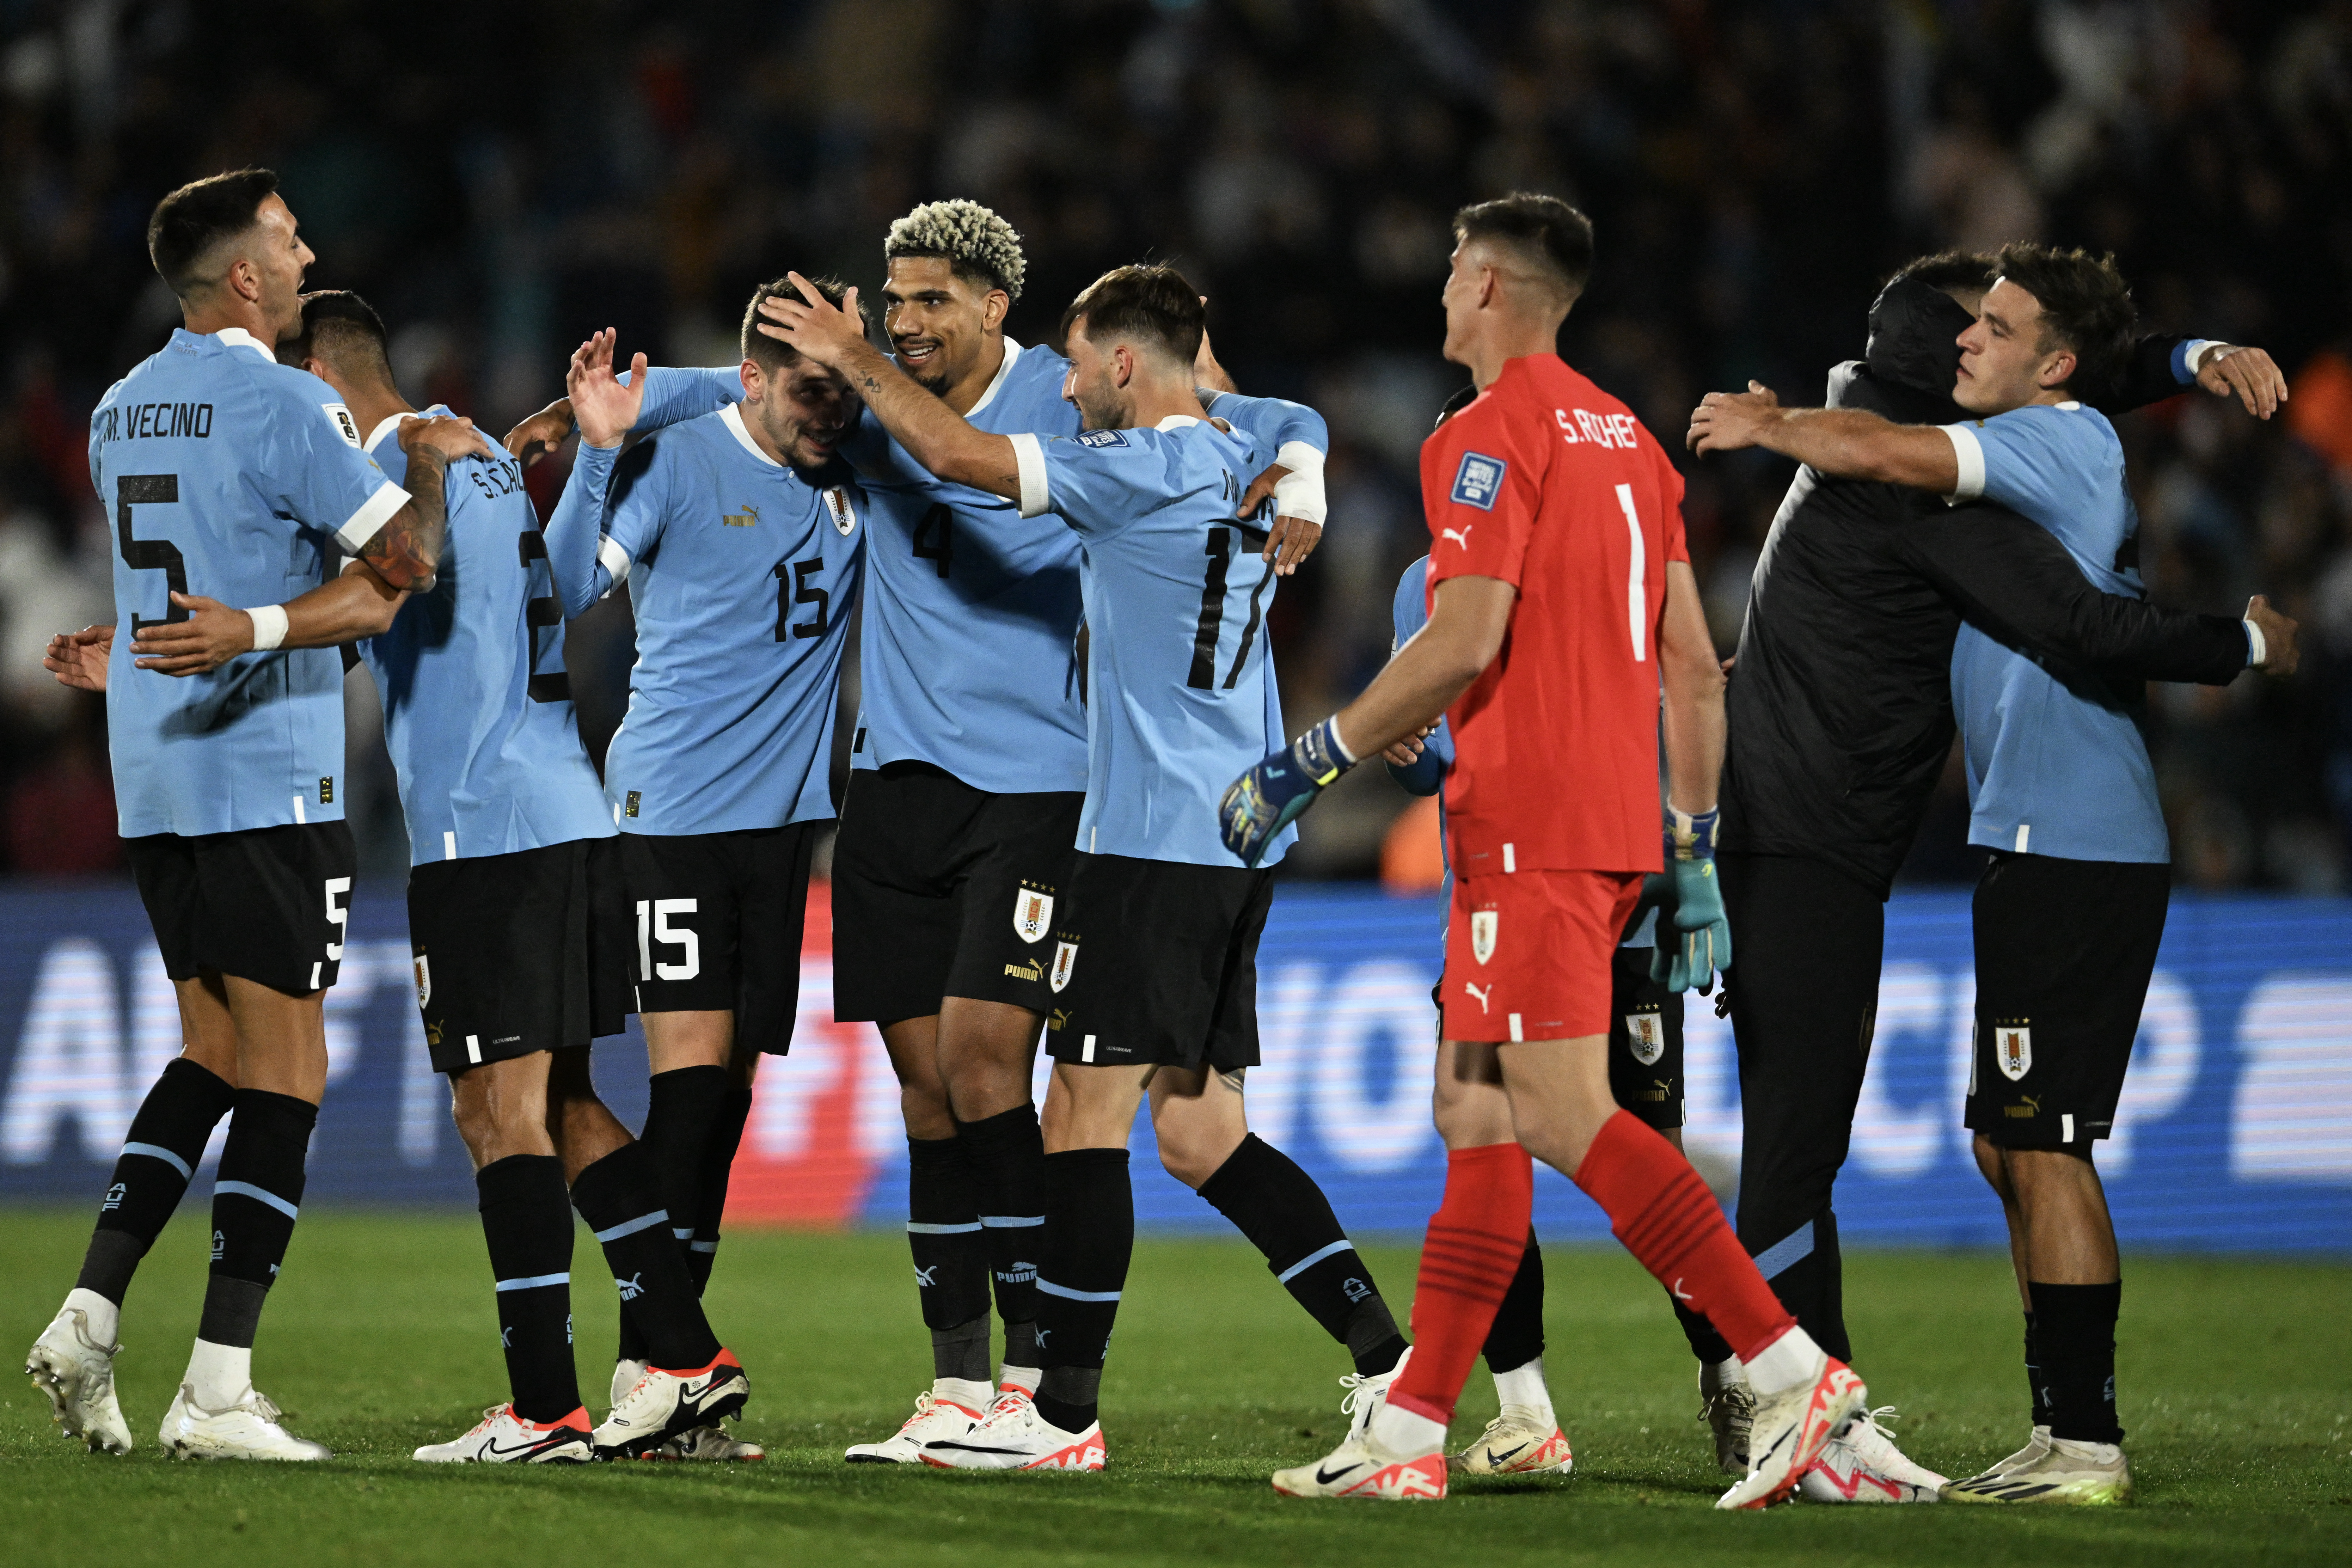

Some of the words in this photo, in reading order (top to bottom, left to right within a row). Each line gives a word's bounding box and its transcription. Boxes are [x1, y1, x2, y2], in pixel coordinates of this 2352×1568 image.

[127, 403, 213, 439] VECINO
[117, 474, 189, 642] 5
[913, 503, 952, 578] 4
[775, 557, 829, 643] 15
[1615, 484, 1645, 661] 1
[519, 531, 573, 703] 2
[1187, 523, 1280, 690] 17
[325, 877, 350, 961] 5
[637, 899, 700, 981] 15
[1004, 964, 1038, 982] PUMA
[492, 1035, 521, 1045] ULTRAWEAVE
[1106, 1042, 1132, 1053] ULTRAWEAVE
[102, 1183, 127, 1212] AUF
[210, 1230, 225, 1262] AUF
[997, 1269, 1037, 1283] PUMA
[1343, 1277, 1372, 1303] AUF
